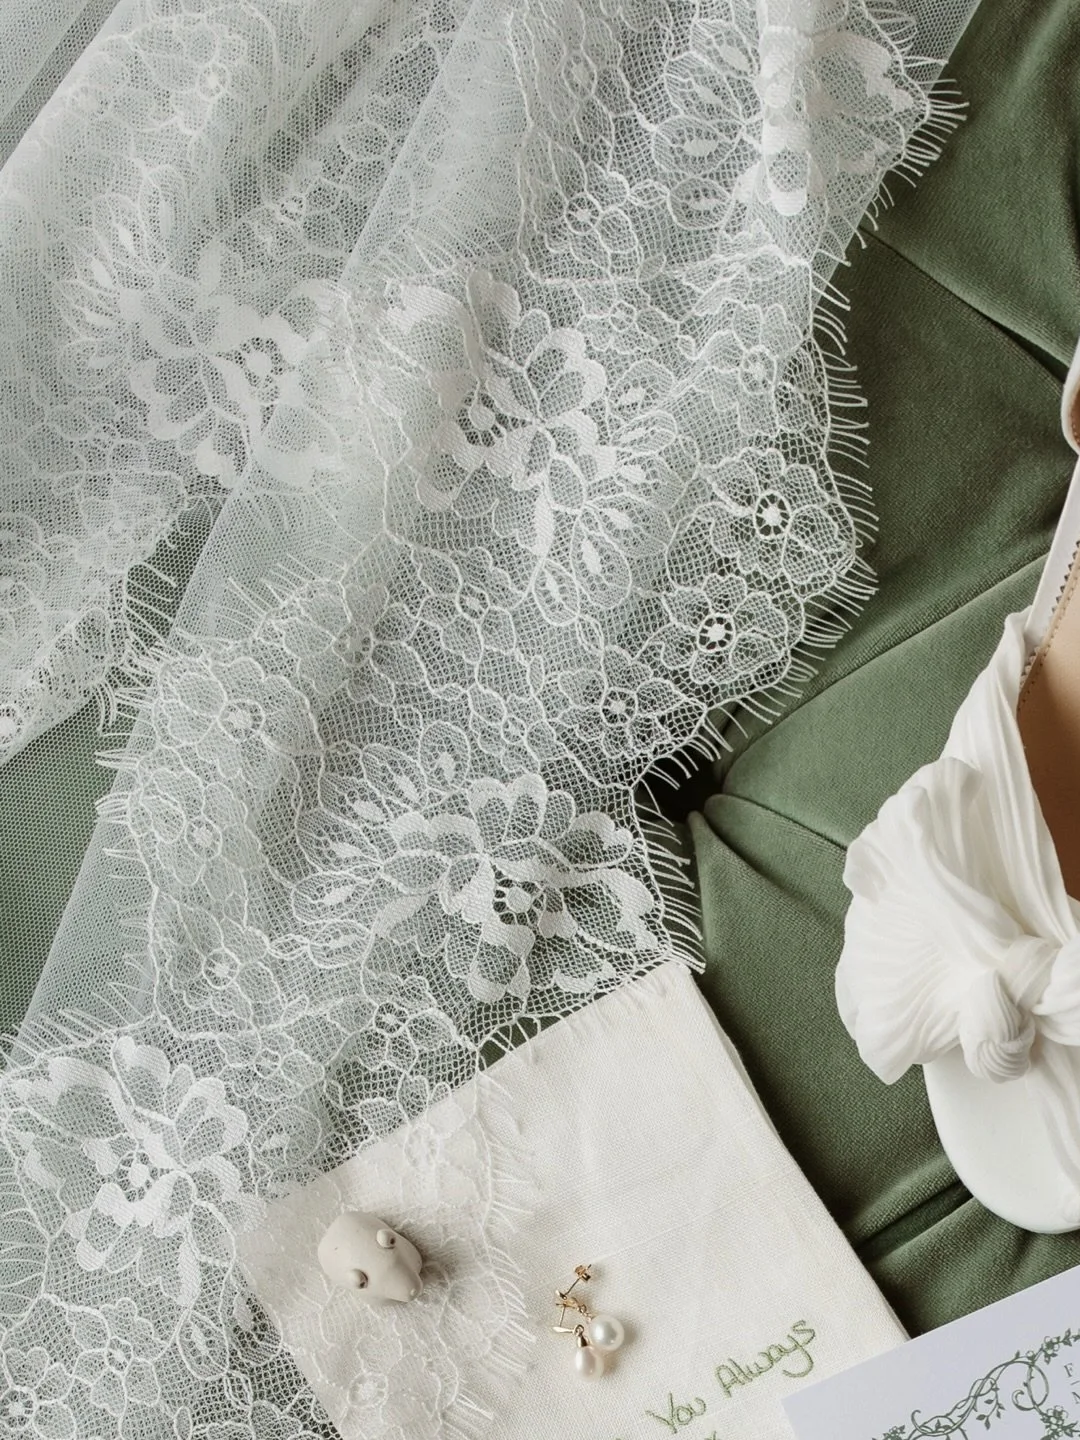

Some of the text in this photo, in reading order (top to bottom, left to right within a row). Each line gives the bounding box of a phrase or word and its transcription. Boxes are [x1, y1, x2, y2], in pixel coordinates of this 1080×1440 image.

[645, 1392, 707, 1434] You
[715, 1319, 816, 1398] Always
[1063, 1362, 1073, 1378] F
